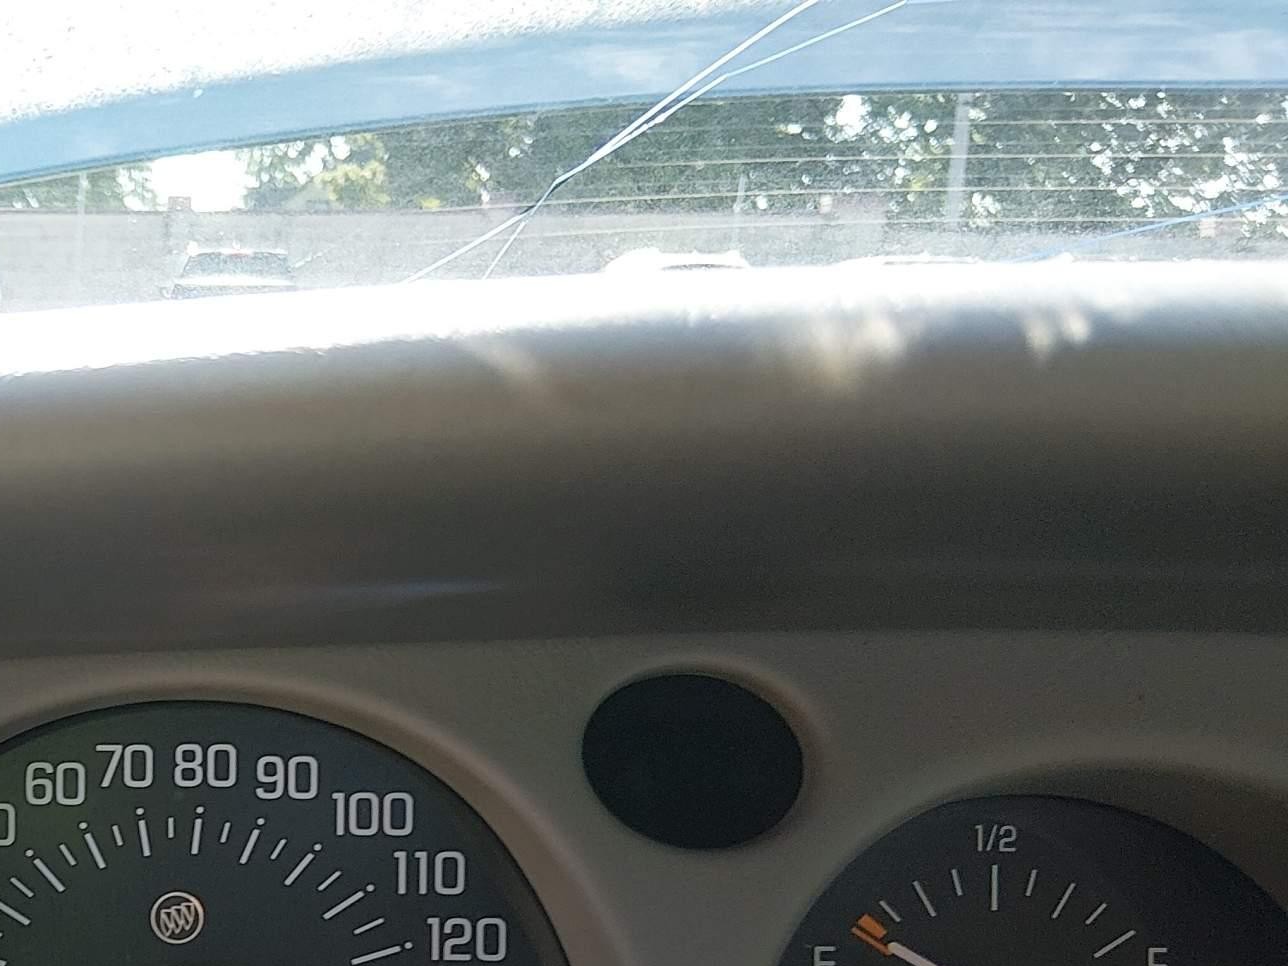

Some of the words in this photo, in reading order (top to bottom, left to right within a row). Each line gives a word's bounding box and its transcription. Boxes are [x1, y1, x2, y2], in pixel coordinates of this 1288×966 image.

[26, 762, 85, 805] 60
[96, 745, 153, 787] 70
[175, 744, 236, 787] 80
[256, 756, 317, 799] 90
[332, 793, 413, 835] 100
[976, 825, 1016, 851] 1/2
[394, 852, 465, 894] 110
[427, 918, 506, 961] 120
